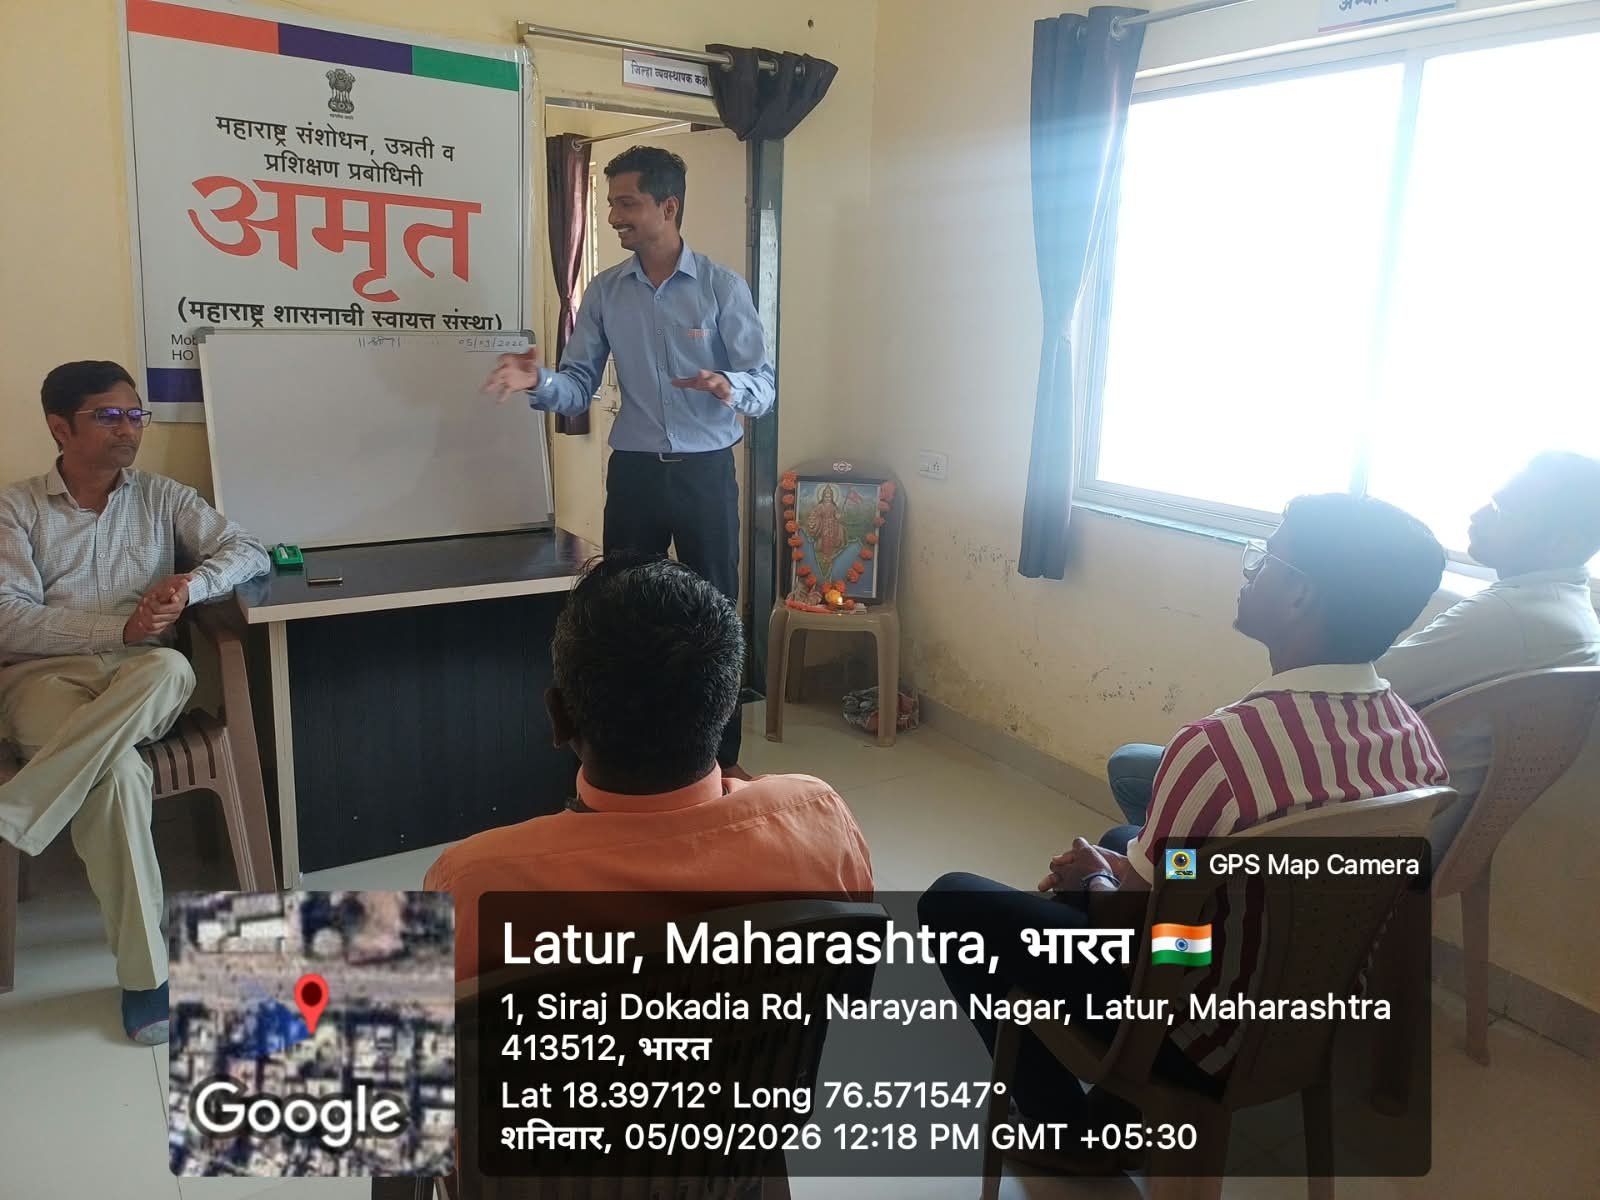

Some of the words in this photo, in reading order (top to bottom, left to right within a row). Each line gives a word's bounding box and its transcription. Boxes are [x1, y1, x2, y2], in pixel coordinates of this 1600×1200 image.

[215, 116, 287, 147] महाराष्ट्र
[296, 122, 375, 156] संशोधन,
[384, 136, 435, 160] उन्नती
[442, 144, 455, 162] व
[264, 150, 340, 178] प्रशिक्षण
[348, 159, 423, 188] प्रबोधिनी
[187, 175, 482, 303] अमृत
[177, 296, 265, 328] (महाराष्ट्र
[273, 303, 364, 327] शासनाची
[371, 310, 436, 330] स्वायत्त
[441, 308, 503, 331] संस्था)
[171, 349, 194, 361] HO
